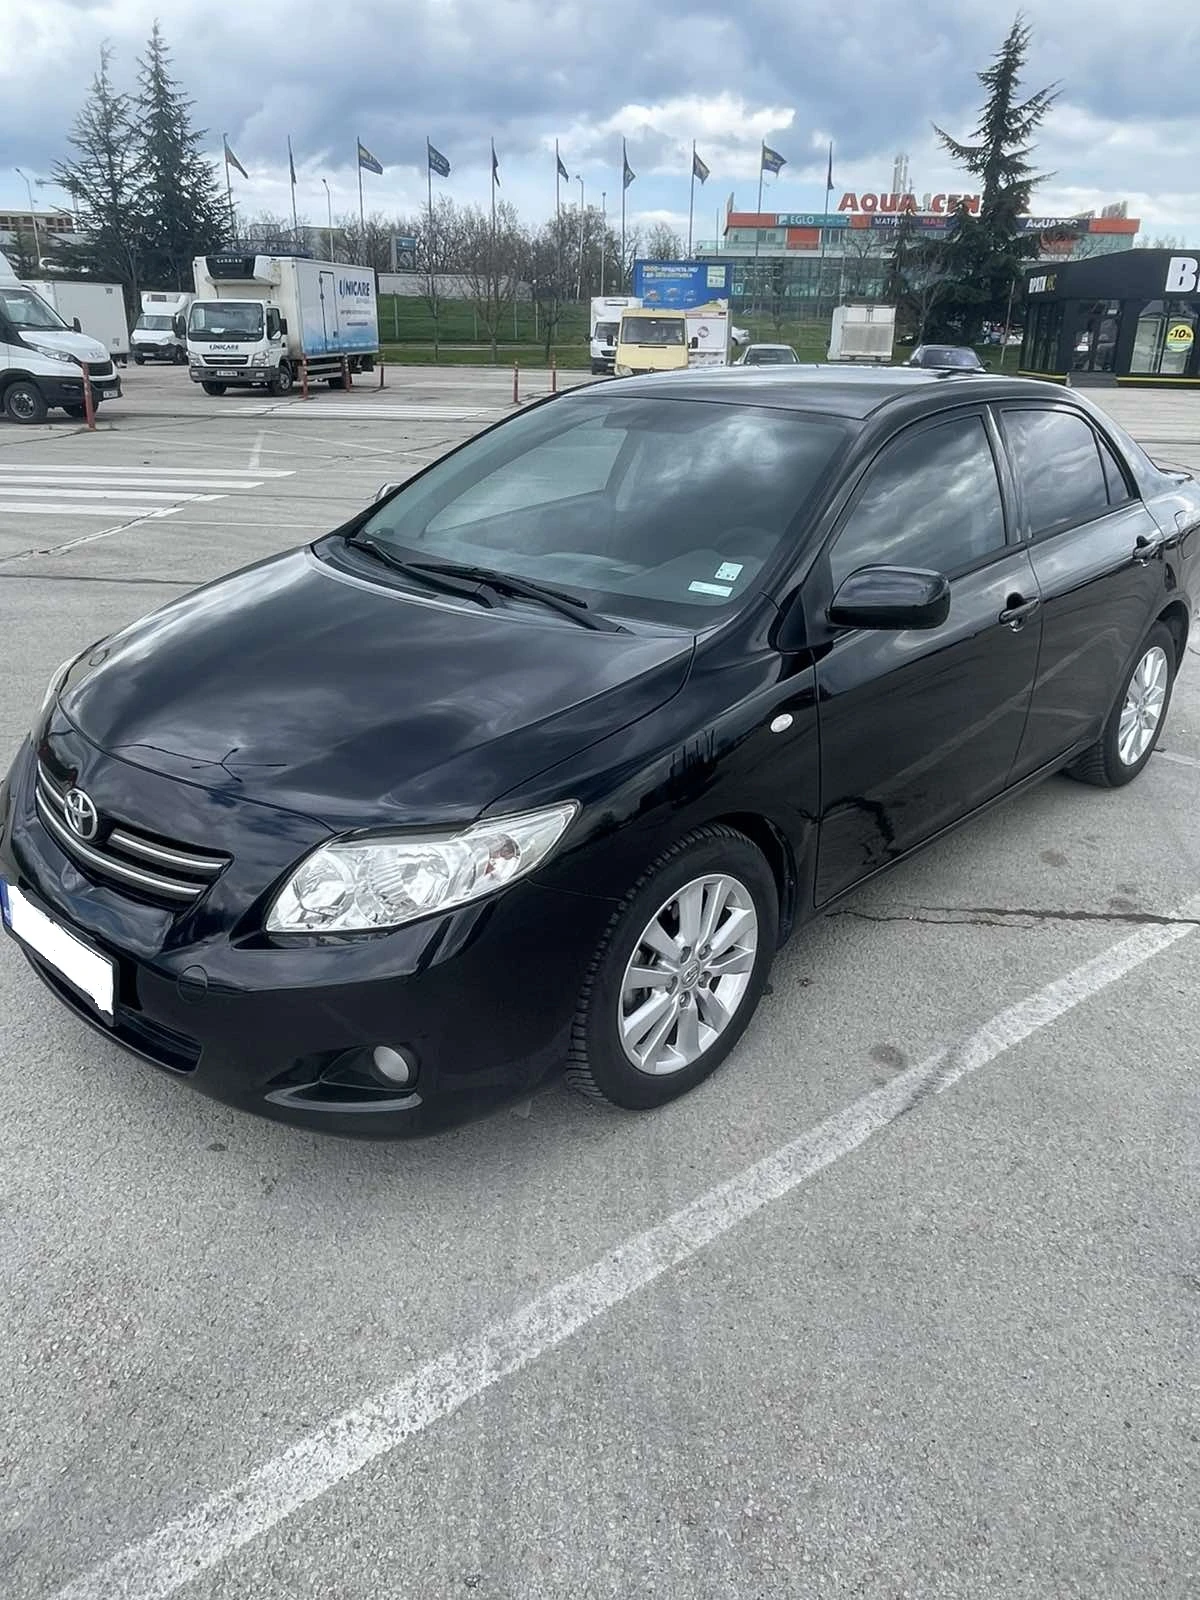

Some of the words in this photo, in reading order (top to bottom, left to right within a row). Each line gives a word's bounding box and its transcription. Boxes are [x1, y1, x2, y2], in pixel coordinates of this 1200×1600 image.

[838, 193, 918, 214] AQUA
[790, 215, 815, 225] EGLO
[339, 277, 370, 298] UNICARE
